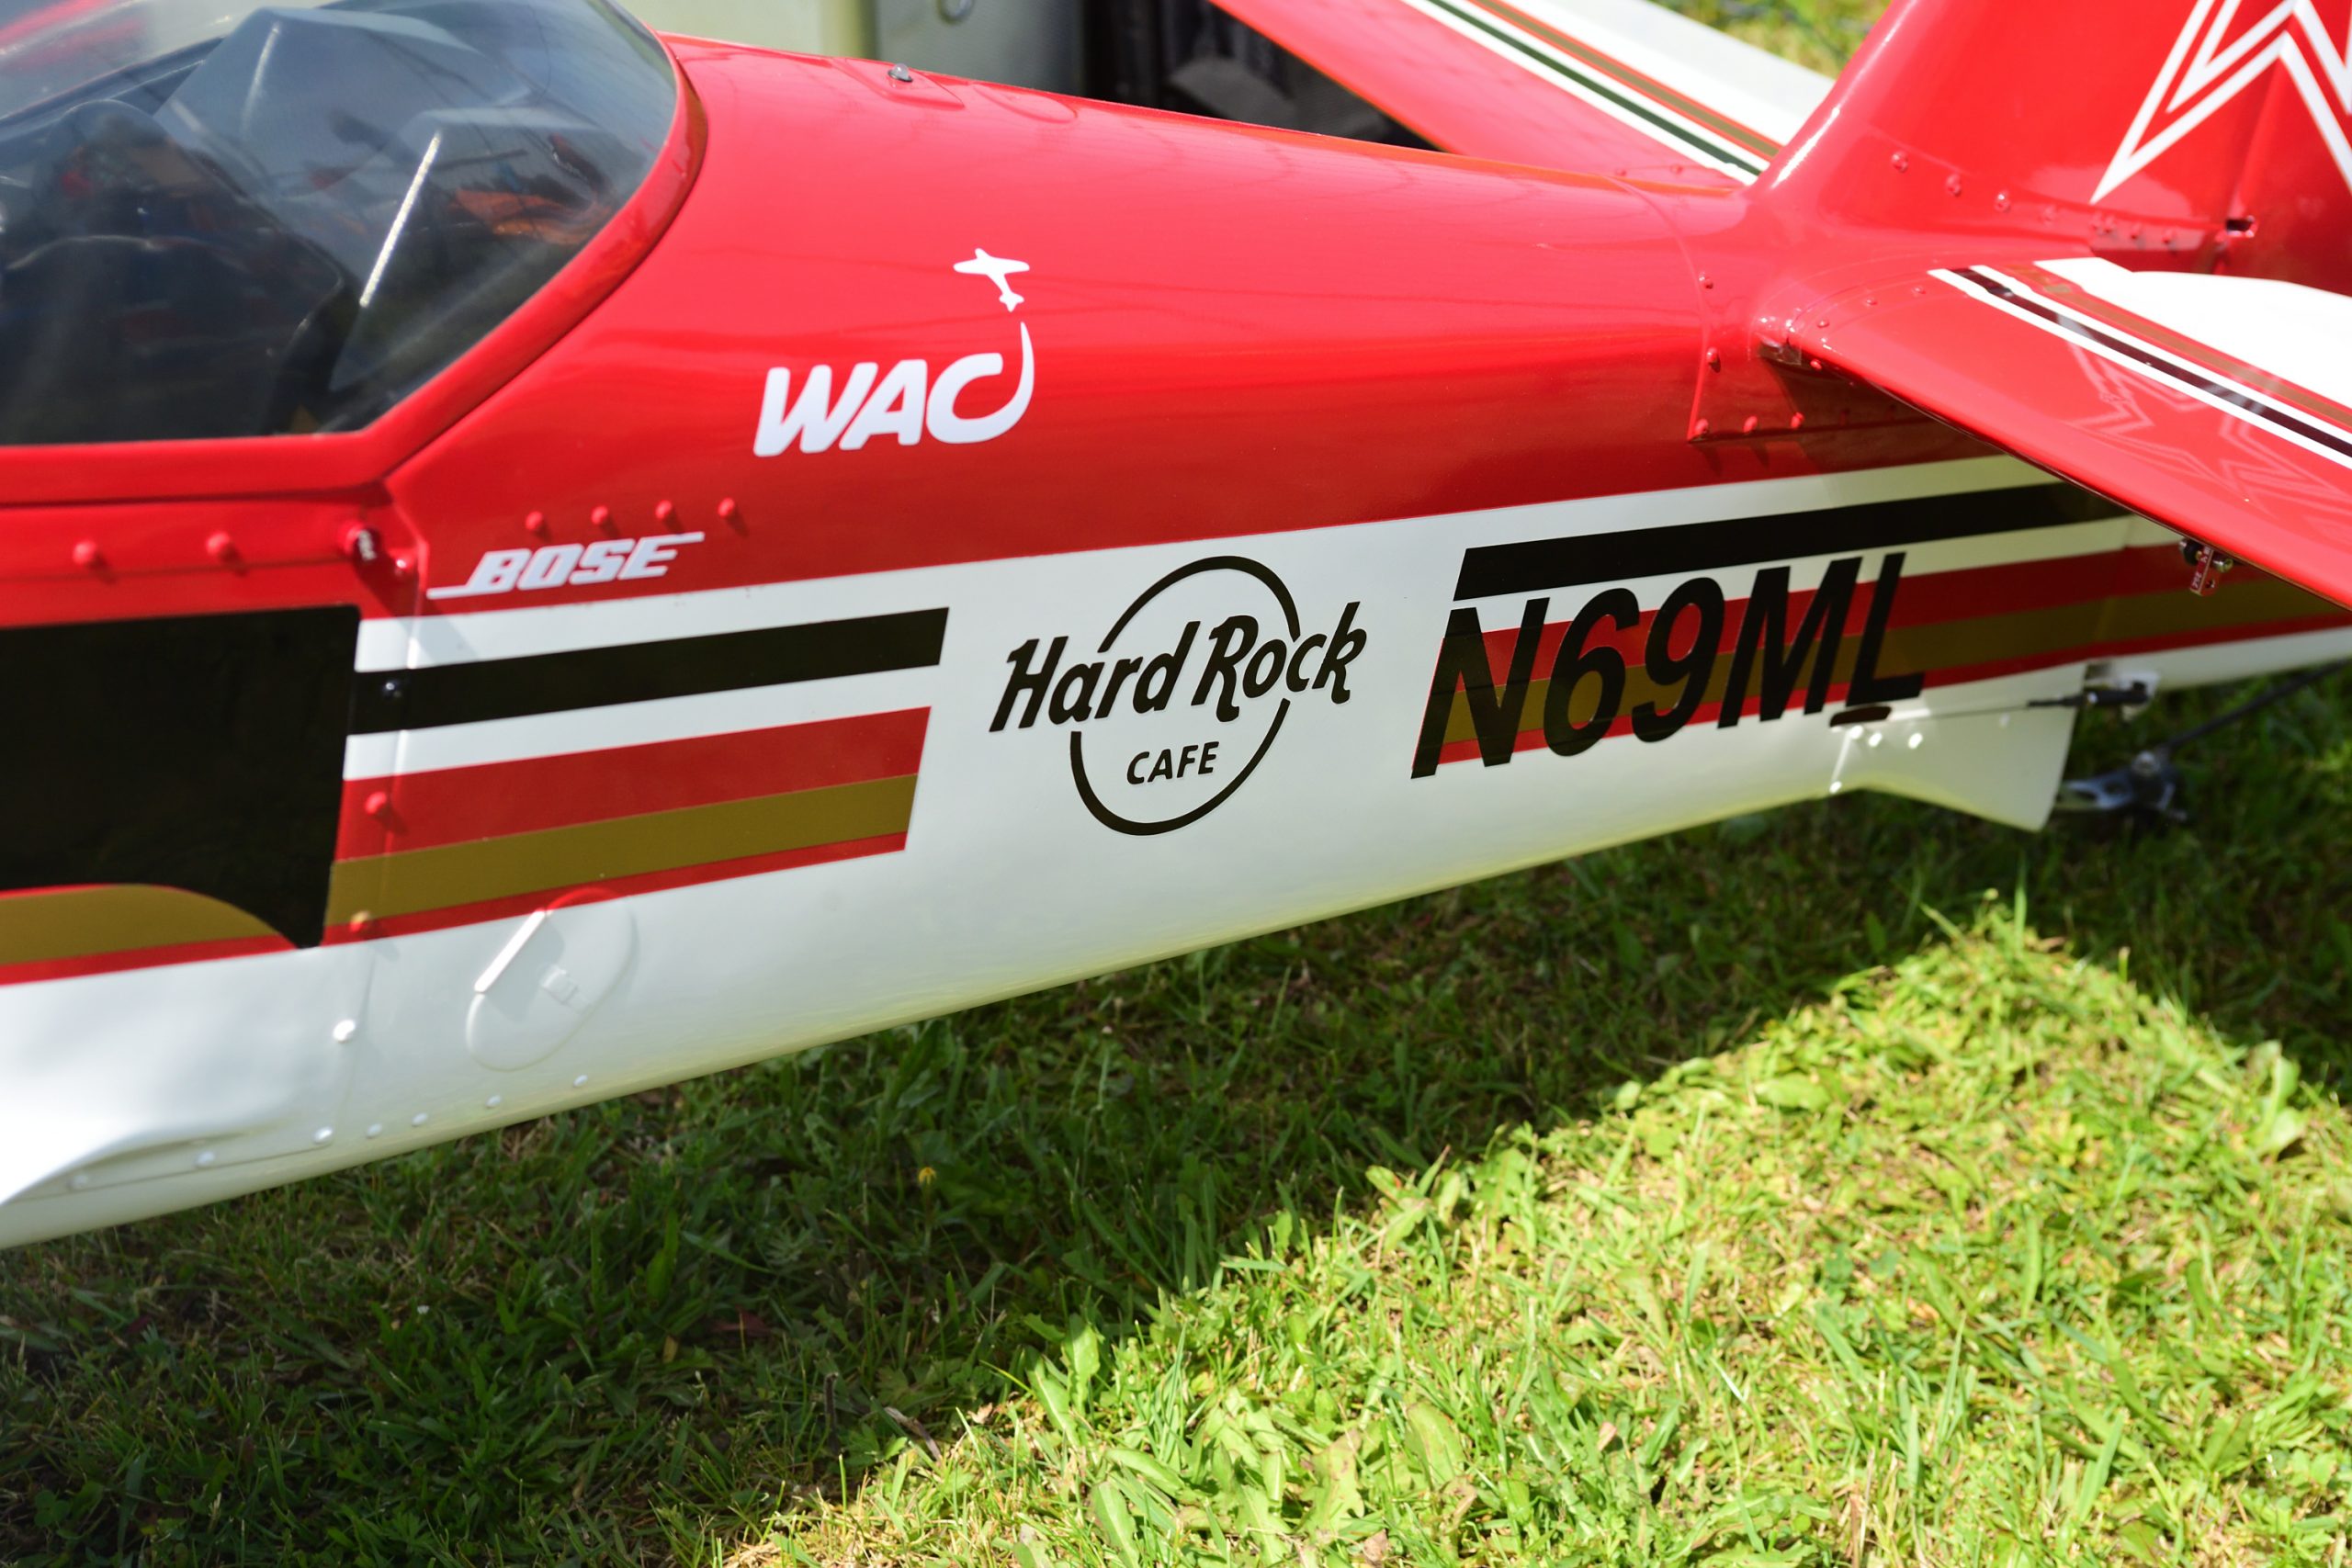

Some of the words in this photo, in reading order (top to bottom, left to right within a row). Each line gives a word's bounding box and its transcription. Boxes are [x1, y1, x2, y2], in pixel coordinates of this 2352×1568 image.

[753, 321, 1035, 457] WAC
[425, 531, 706, 600] BOSE
[989, 621, 1202, 733] Hard
[1191, 602, 1368, 723] Rock
[1410, 551, 1926, 780] N69ML
[1126, 741, 1220, 786] CAFE
